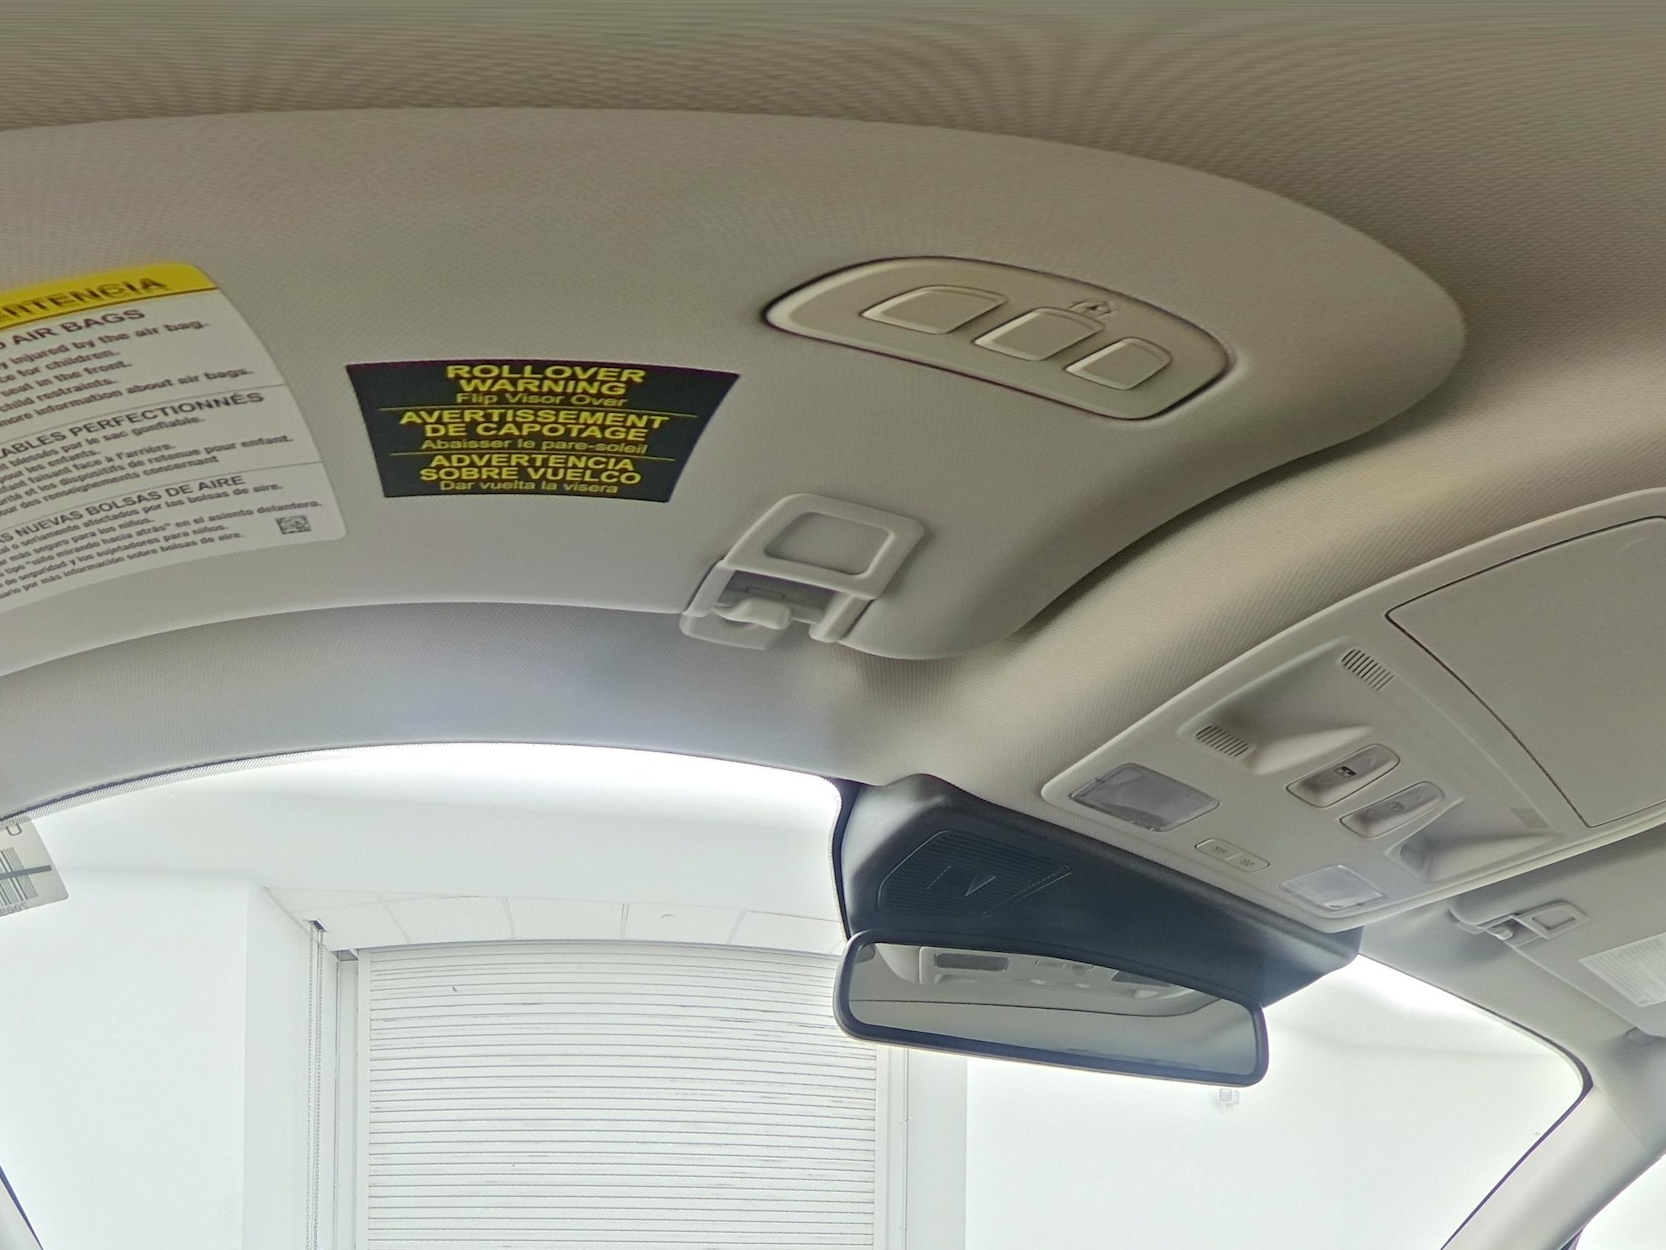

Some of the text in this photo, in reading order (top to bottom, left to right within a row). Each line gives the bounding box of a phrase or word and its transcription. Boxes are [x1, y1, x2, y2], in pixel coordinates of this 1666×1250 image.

[12, 327, 60, 346] AIR
[59, 309, 146, 333] BAGS
[446, 364, 646, 382] ROLLOVER
[459, 378, 626, 395] WARNING
[456, 393, 629, 407] Flip Visor Over
[399, 409, 671, 429] AVERTISSEMENT
[425, 423, 649, 441] DE CAPOTAGE
[421, 439, 648, 454] Abaisser le pare-soleil
[430, 454, 635, 471] ADVERTENCIA
[420, 468, 641, 485] SOBRE VUELCO
[440, 480, 619, 494] Dar vuelta la visera
[15, 511, 84, 537] NUEVAS
[85, 491, 162, 516] BOLSAS
[164, 484, 194, 497] DE
[198, 475, 245, 491] AIRE
